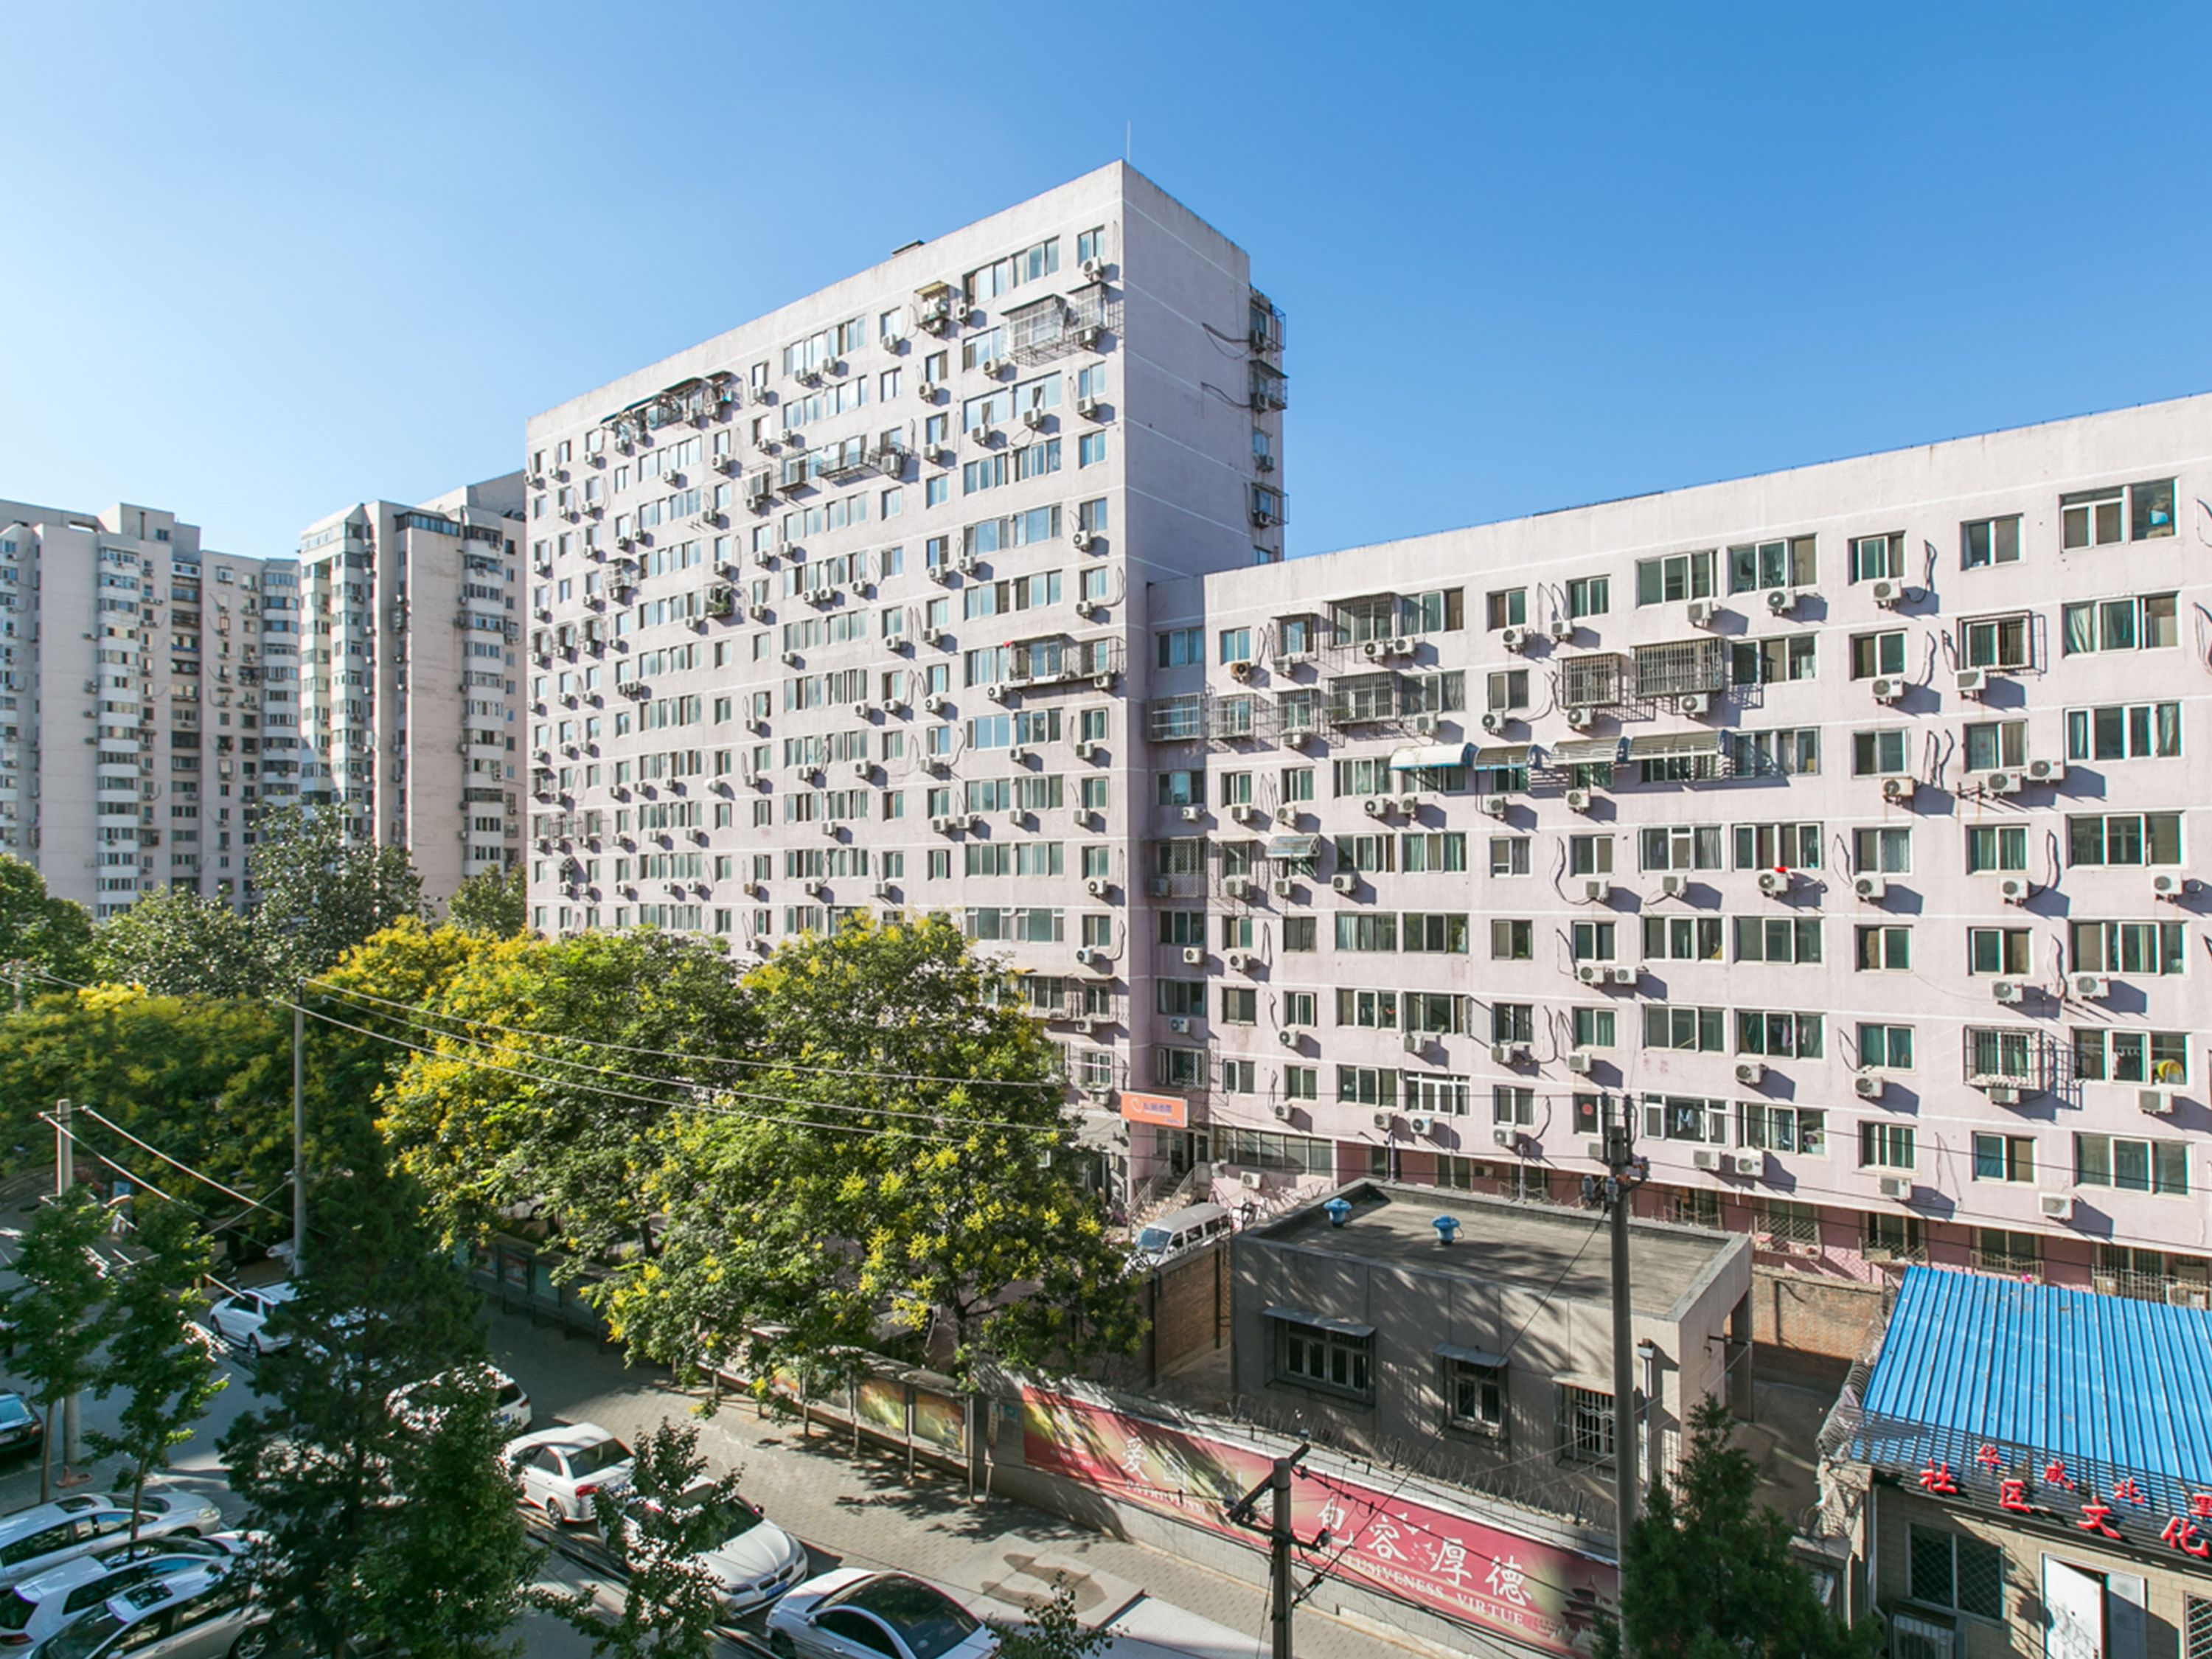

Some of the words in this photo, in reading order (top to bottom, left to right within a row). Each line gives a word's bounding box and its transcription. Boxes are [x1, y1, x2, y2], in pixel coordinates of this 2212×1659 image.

[1919, 1457, 2210, 1558] 社区文化
[1976, 1443, 2212, 1518] 华威北里
[1316, 1497, 1408, 1562] 包容
[1430, 1537, 1533, 1607] 厚德
[1455, 1592, 1524, 1627] VIRTUE
